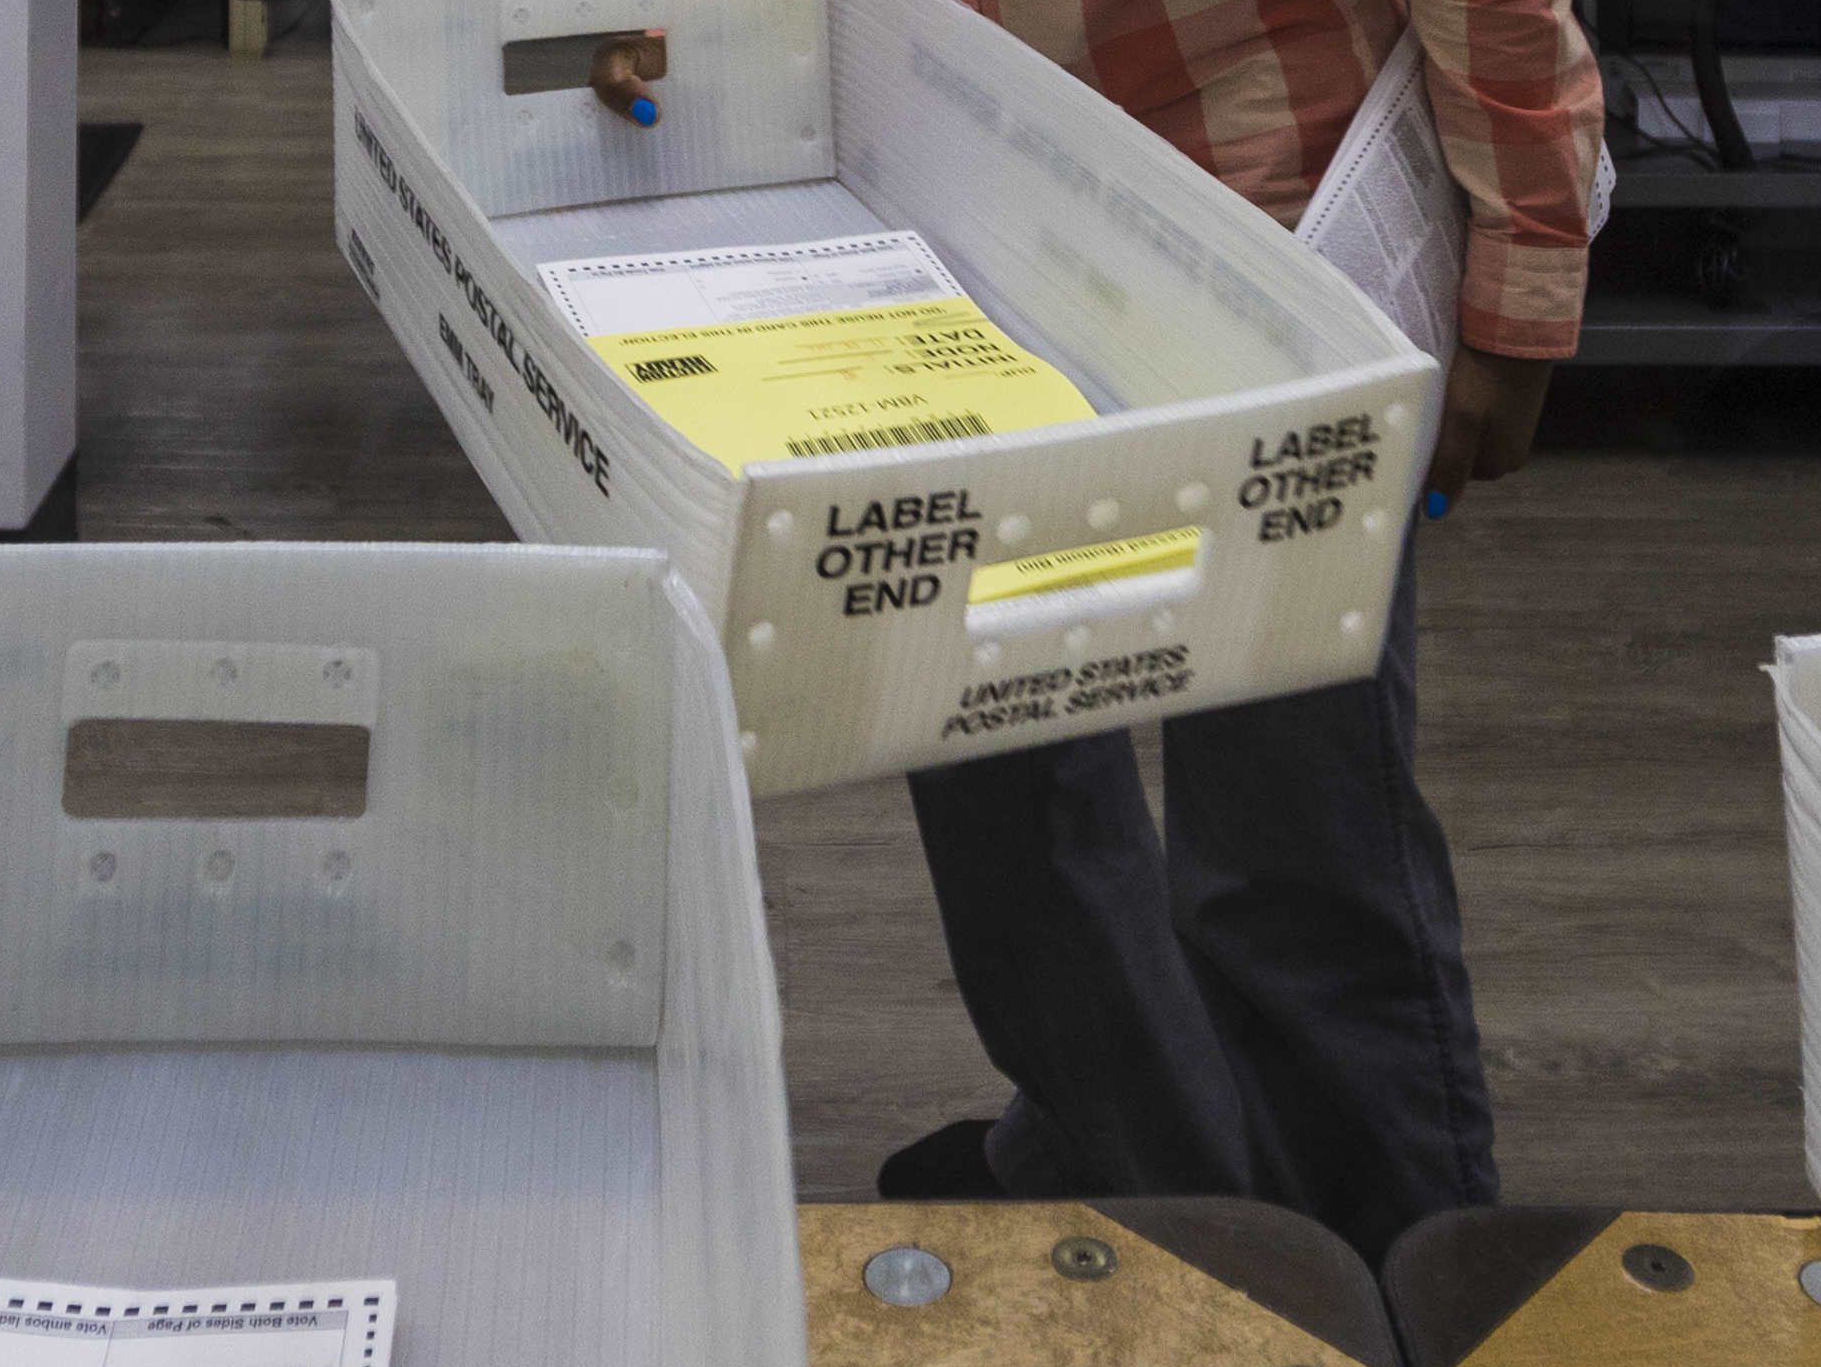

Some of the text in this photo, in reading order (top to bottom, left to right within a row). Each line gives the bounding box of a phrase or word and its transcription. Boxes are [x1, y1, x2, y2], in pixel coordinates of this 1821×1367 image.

[354, 105, 398, 196] UNITED
[399, 180, 452, 275] STATES
[455, 263, 520, 372] POSTAL
[522, 352, 610, 499] SERVICE
[439, 313, 495, 414] EMM TRAY
[807, 393, 929, 423] VBM-12521
[1249, 413, 1380, 471] LABEL
[1238, 450, 1378, 510] OTHER
[826, 490, 982, 538] LABEL
[1258, 498, 1344, 544] END
[816, 530, 981, 581] OTHER
[843, 574, 942, 617] END
[960, 644, 1190, 710] UNITED STATES
[941, 668, 1195, 740] POSTAL SERVICE
[24, 1318, 76, 1333] ambos
[77, 1321, 108, 1336] Vote
[147, 1315, 319, 1333] Vote Both Sides of Page
